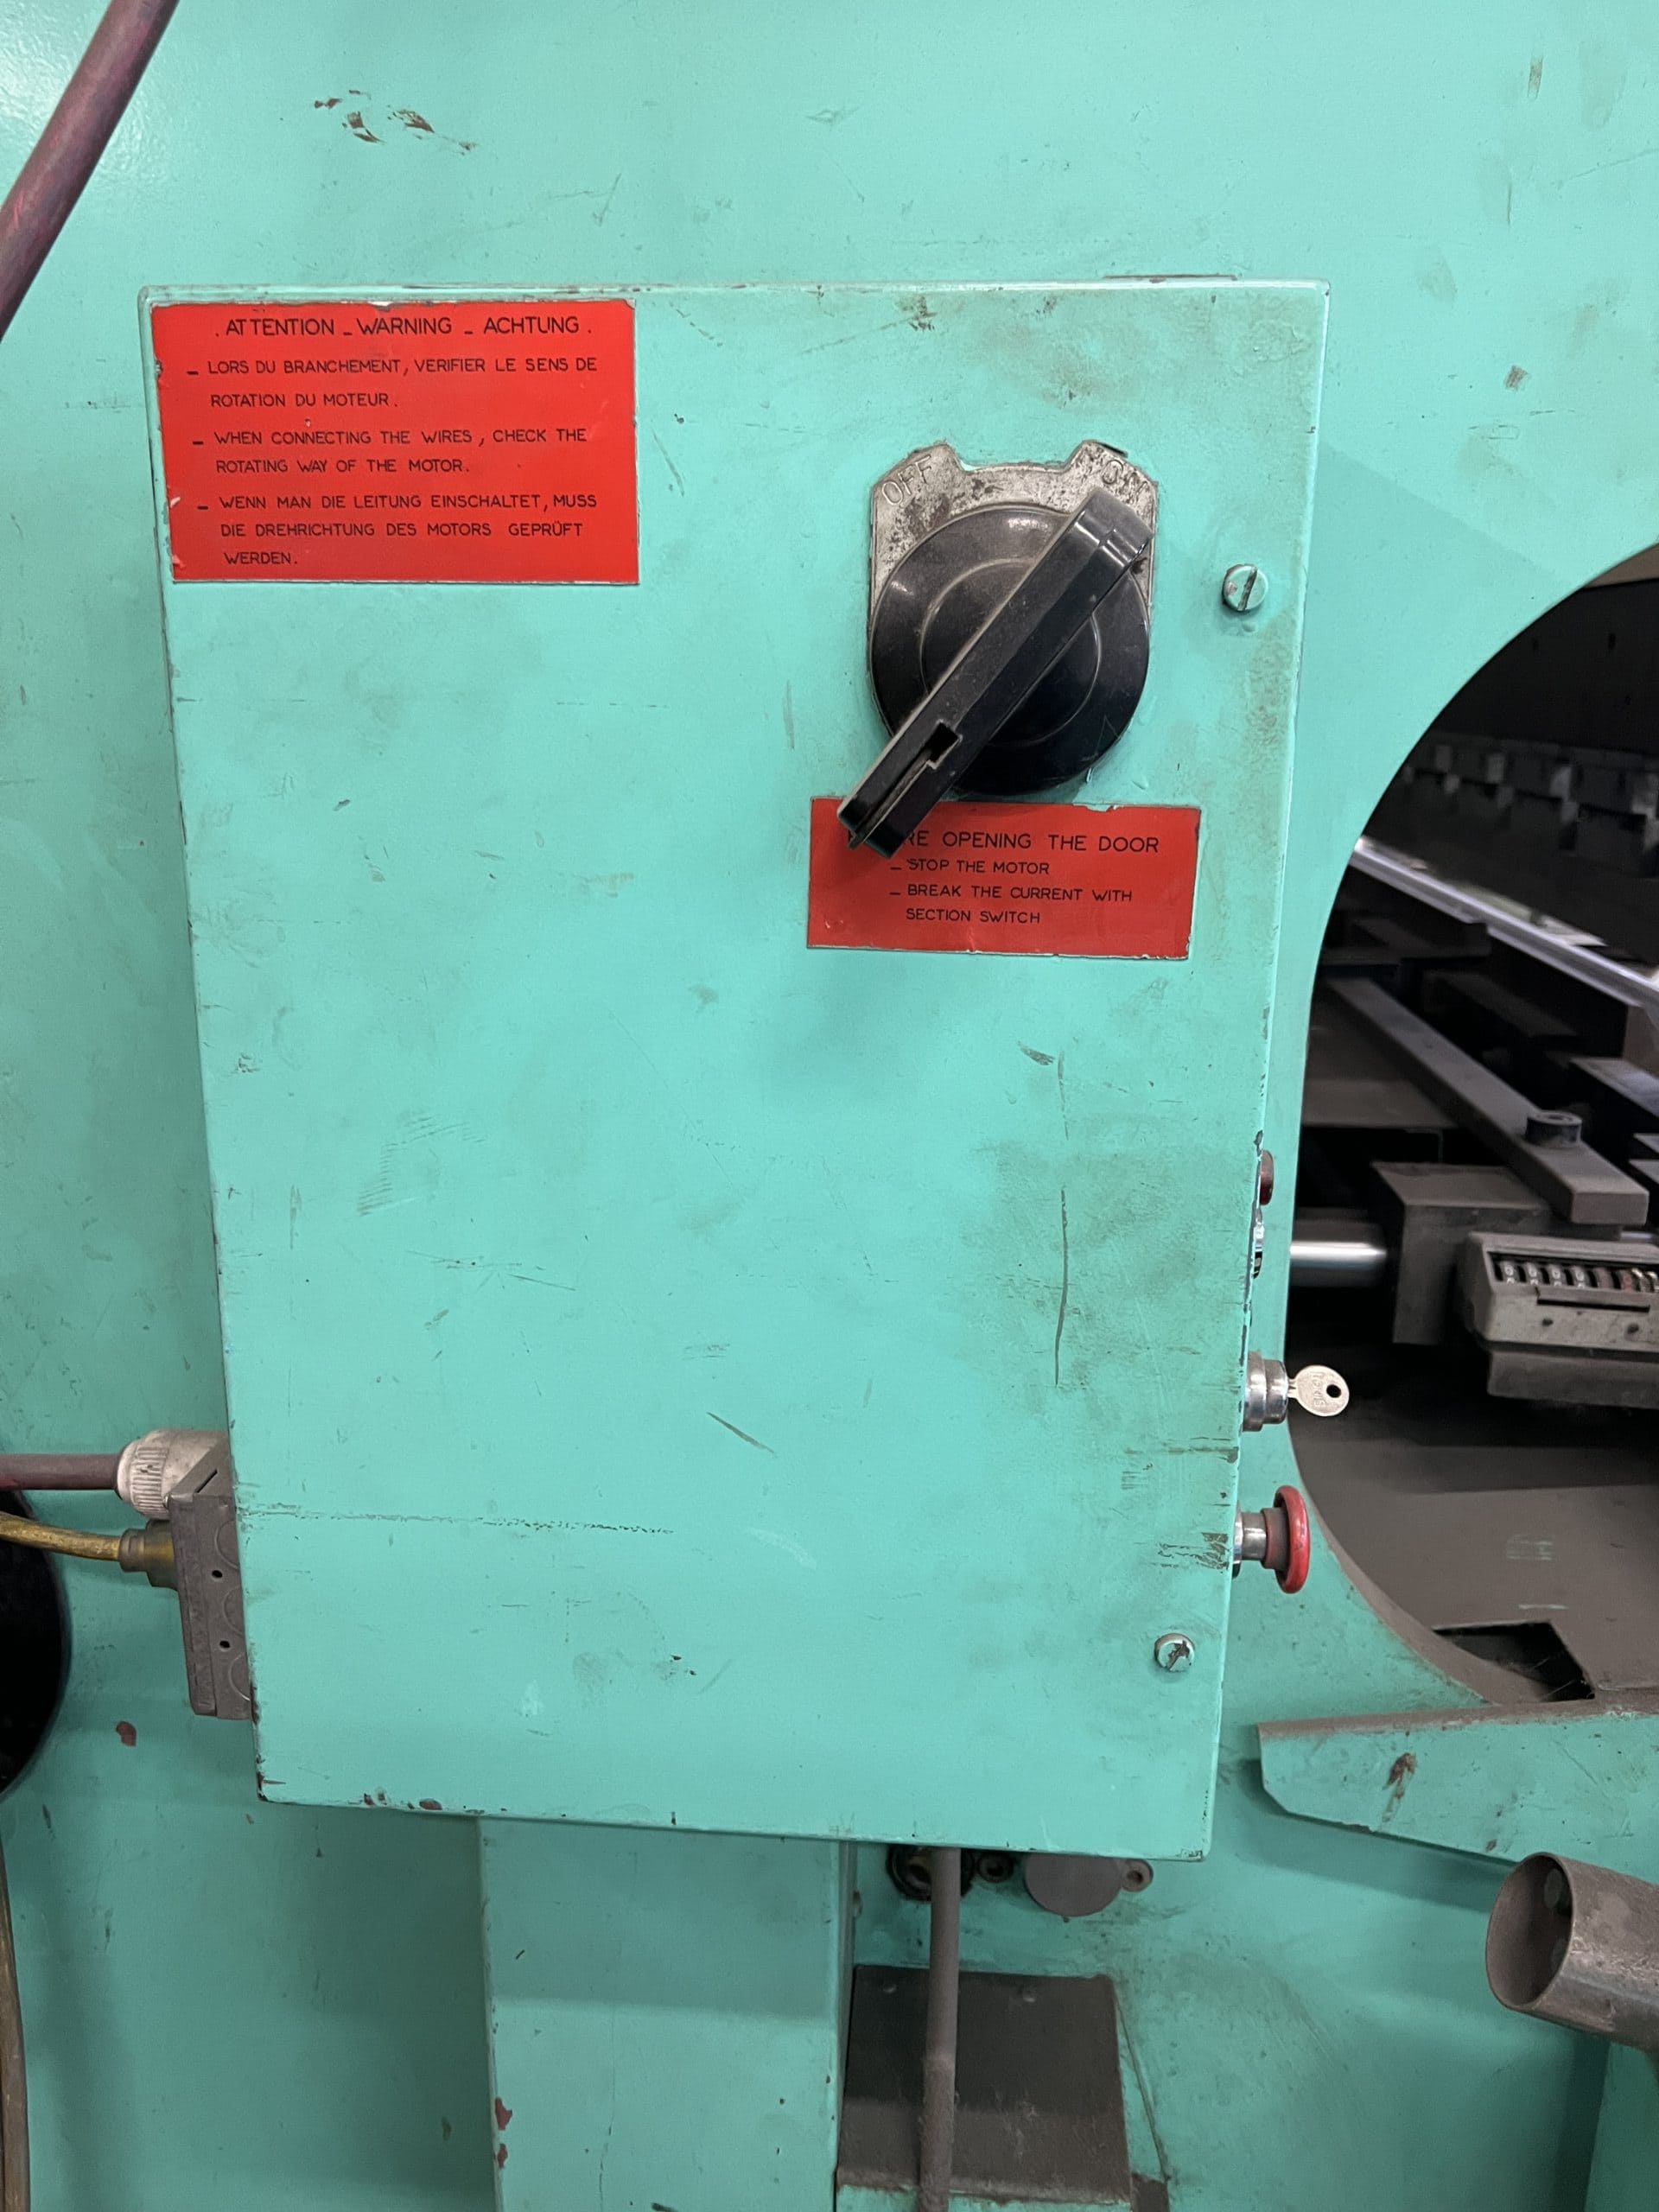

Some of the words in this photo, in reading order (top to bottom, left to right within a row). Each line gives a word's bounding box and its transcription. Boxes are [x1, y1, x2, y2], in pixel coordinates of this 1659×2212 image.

[226, 318, 335, 337] ATTENTION
[356, 316, 453, 336] WARNING
[483, 315, 580, 335] ACHTUNG
[207, 359, 250, 375] LORS
[255, 359, 276, 374] DU
[414, 358, 486, 373] VERIFIER
[495, 357, 517, 372] LE
[524, 357, 569, 372] SENS
[575, 357, 598, 372] DE
[210, 393, 286, 408] ROTATION
[295, 393, 316, 408] DU
[213, 430, 263, 445] WHEN
[270, 430, 372, 445] CONNECTING
[379, 430, 411, 445] THE
[492, 429, 547, 443] CHECK
[556, 428, 588, 442] THE
[215, 459, 289, 474] ROTATING
[297, 459, 327, 474] WAY
[335, 459, 357, 473] OF
[365, 458, 397, 473] THE
[881, 454, 931, 505] OFF
[219, 495, 266, 510] WENN
[276, 496, 312, 509] MAN
[321, 495, 346, 509] DIE
[353, 494, 422, 509] LEITUNG
[552, 493, 598, 508] MUSS
[220, 523, 246, 537] DIE
[255, 523, 375, 537] DREHRICHTUNG
[385, 522, 417, 537] DES
[427, 522, 492, 537] MOTORS
[508, 520, 583, 537] GEPRÜFT
[942, 831, 1032, 849] OPENING
[1047, 834, 1087, 852] THE
[1098, 835, 1160, 854] DOOR
[906, 858, 950, 871] STOP
[956, 860, 986, 874] THE
[993, 861, 1050, 875] MOTOR
[907, 883, 962, 897] BREAK
[971, 885, 1002, 899] THE
[1009, 887, 1084, 901] CURRENT
[1091, 889, 1133, 902] WITH
[906, 907, 971, 922] SECTION
[980, 910, 1040, 924] SWITCH
